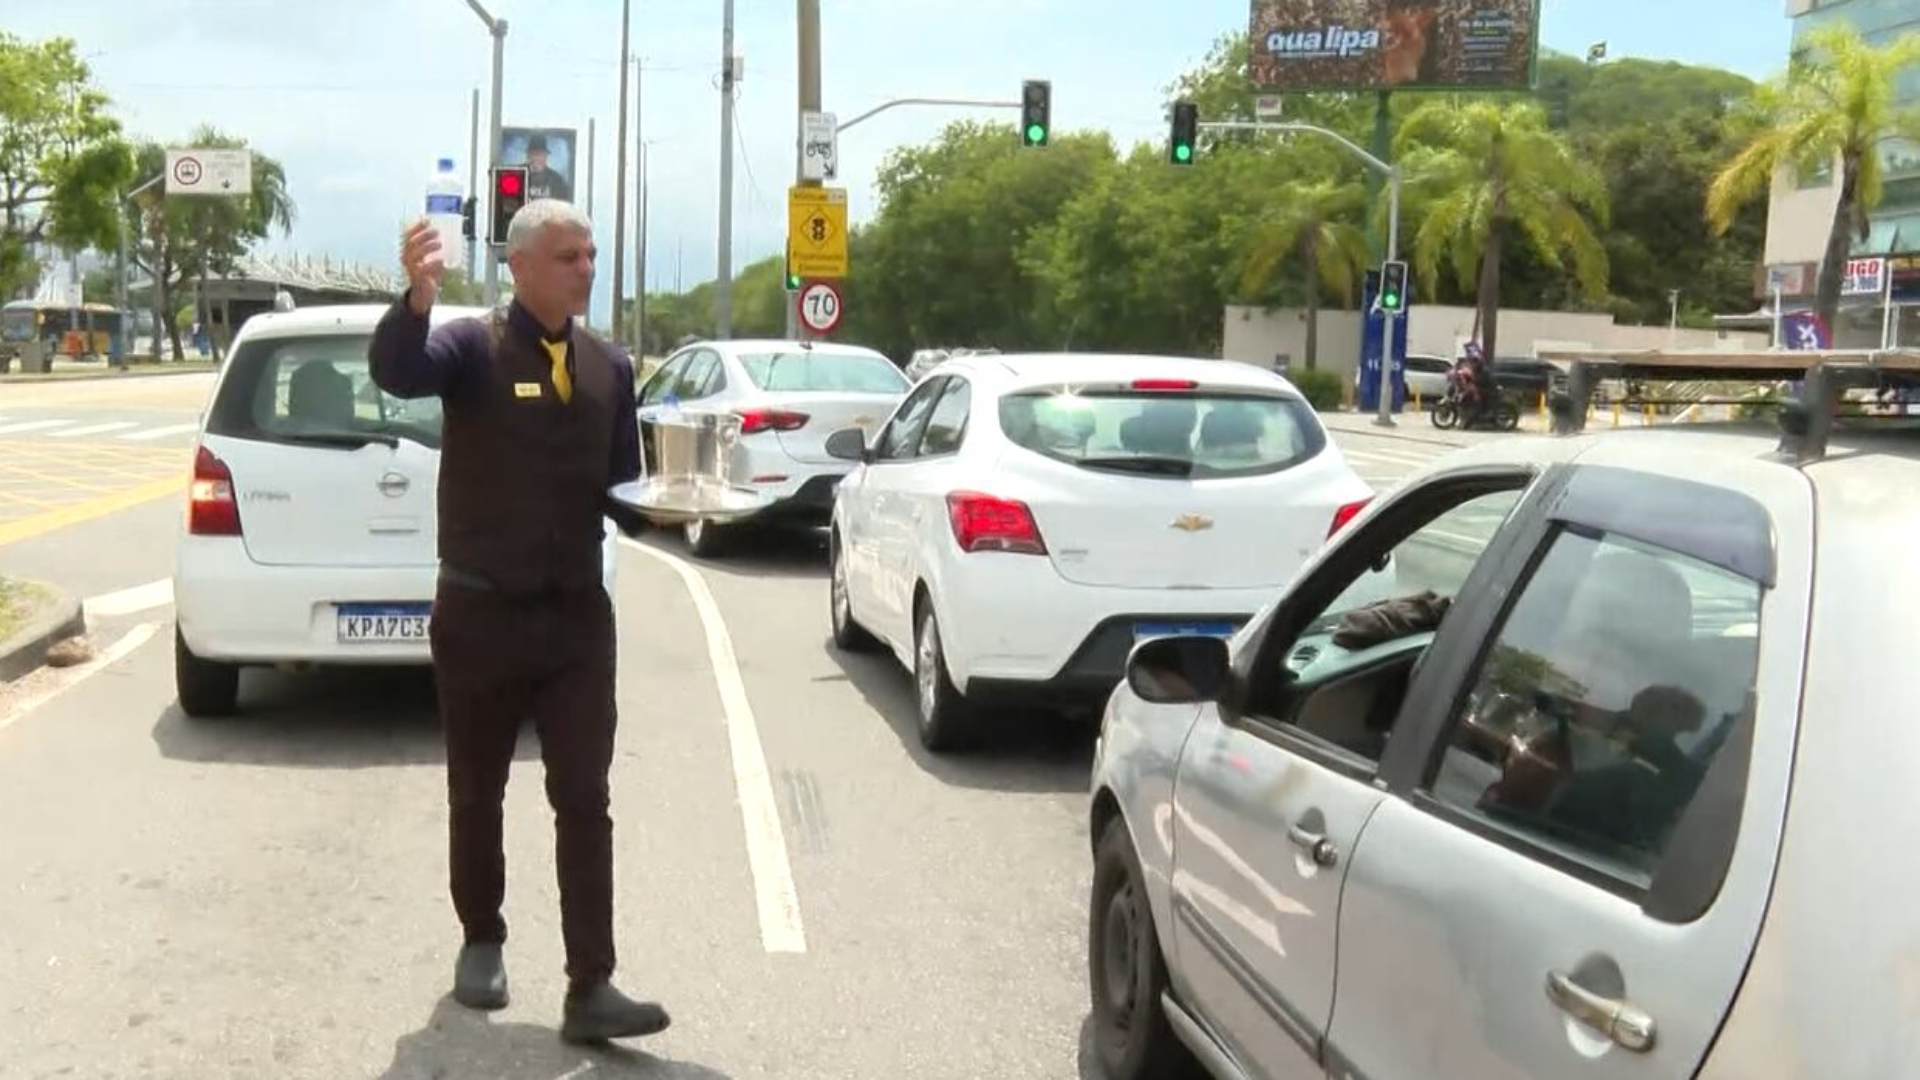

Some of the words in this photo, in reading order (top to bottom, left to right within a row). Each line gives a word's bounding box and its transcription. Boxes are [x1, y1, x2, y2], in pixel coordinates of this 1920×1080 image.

[1325, 25, 1379, 56] lipa
[808, 293, 836, 317] 70
[347, 616, 430, 637] KPA7C3
